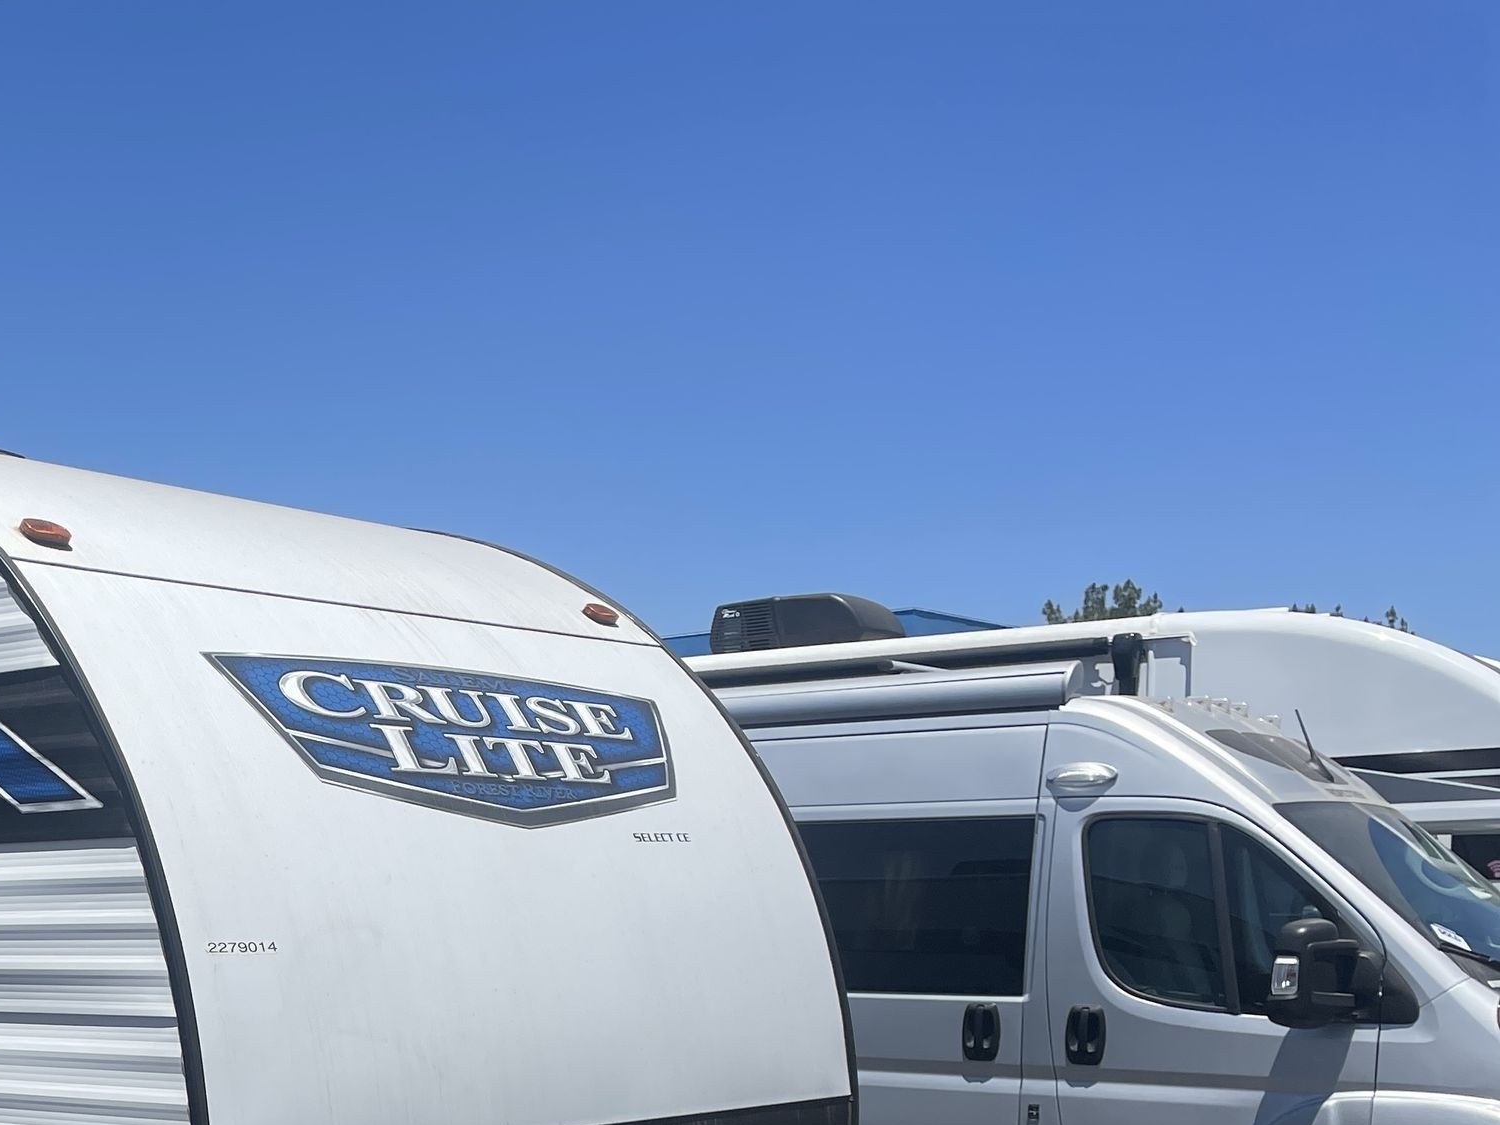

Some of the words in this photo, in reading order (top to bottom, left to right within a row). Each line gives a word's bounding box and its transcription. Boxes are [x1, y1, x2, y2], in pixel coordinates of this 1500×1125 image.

[278, 670, 634, 742] CRUISE
[368, 723, 613, 785] LITE
[450, 780, 518, 797] FOREST
[522, 784, 577, 799] RIVER
[632, 832, 674, 842] SELECT
[676, 832, 691, 842] CE
[207, 941, 278, 953] 2279014
